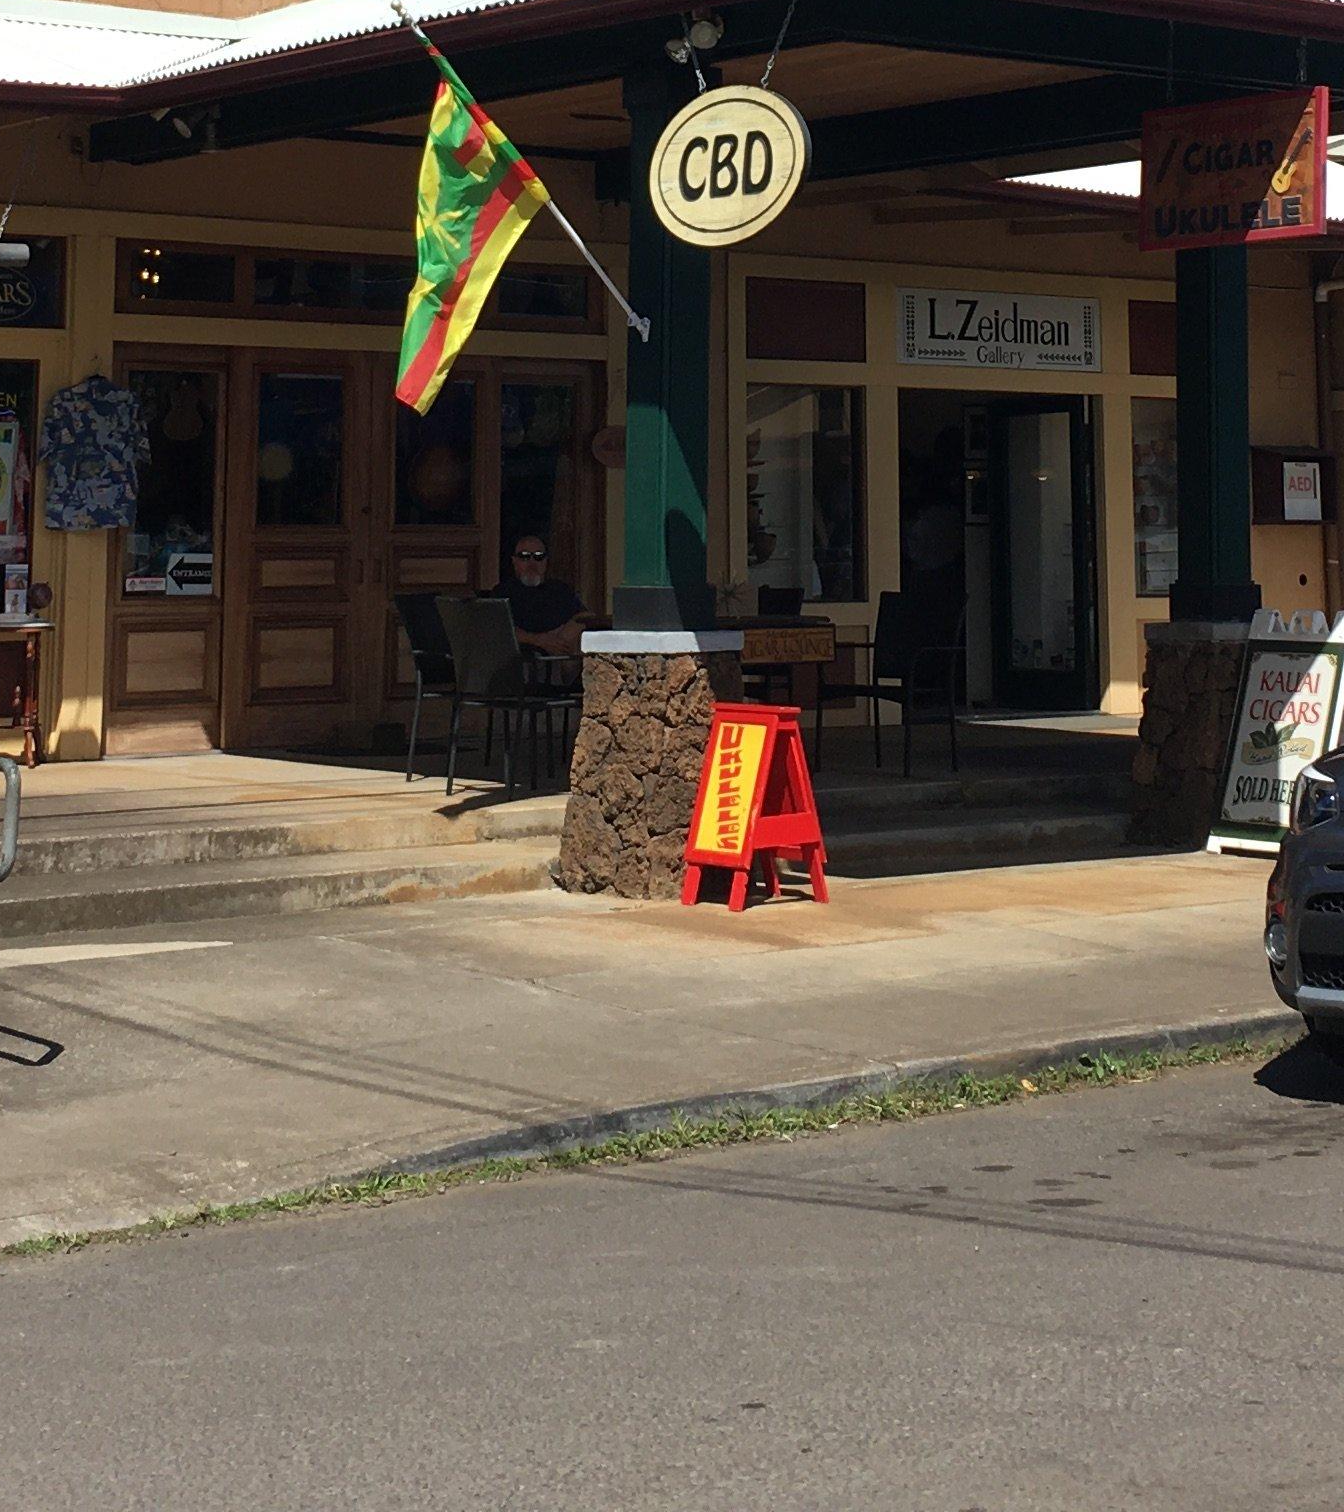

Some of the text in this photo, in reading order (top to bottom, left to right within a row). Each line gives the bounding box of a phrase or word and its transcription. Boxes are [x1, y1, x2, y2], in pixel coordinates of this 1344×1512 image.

[679, 130, 774, 202] CBD
[1183, 140, 1274, 174] CIGAR
[1154, 195, 1302, 238] UKULELE
[976, 345, 1025, 368] Gallery
[1288, 476, 1313, 492] AED
[1260, 671, 1321, 694] KAUAI
[1249, 699, 1321, 724] CIGARS
[717, 725, 745, 850] UKULELES
[1232, 775, 1269, 806] SOLD
